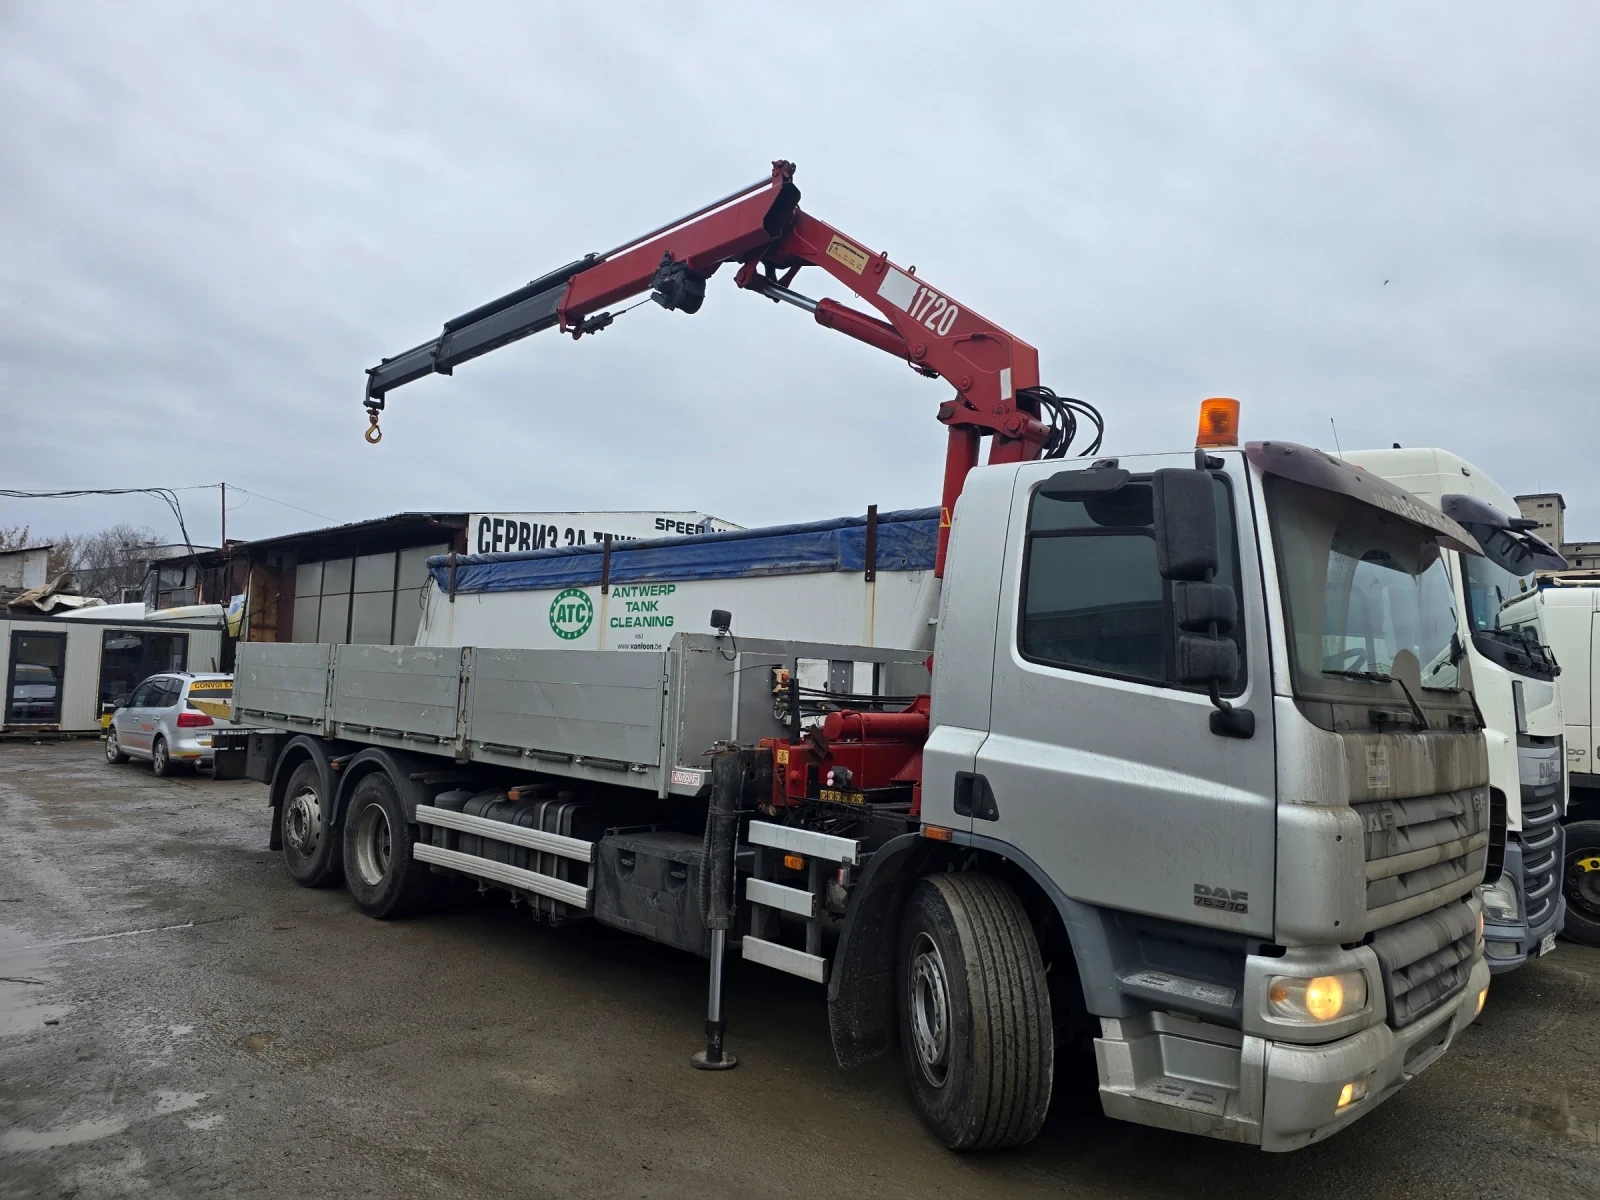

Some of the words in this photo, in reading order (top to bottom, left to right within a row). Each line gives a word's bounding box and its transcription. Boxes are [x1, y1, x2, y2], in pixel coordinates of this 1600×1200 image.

[910, 287, 959, 336] 1720
[655, 517, 705, 535] SPEED
[478, 516, 558, 554] СЕРВИЗ
[612, 584, 676, 598] ANTWERP
[556, 603, 586, 623] ATC
[625, 600, 659, 612] TANK
[610, 615, 674, 628] CLEANING
[617, 642, 662, 650] www.vanloon.be
[1361, 809, 1393, 833] AF
[1194, 884, 1248, 900] DAF
[1194, 896, 1247, 912] 75.310
